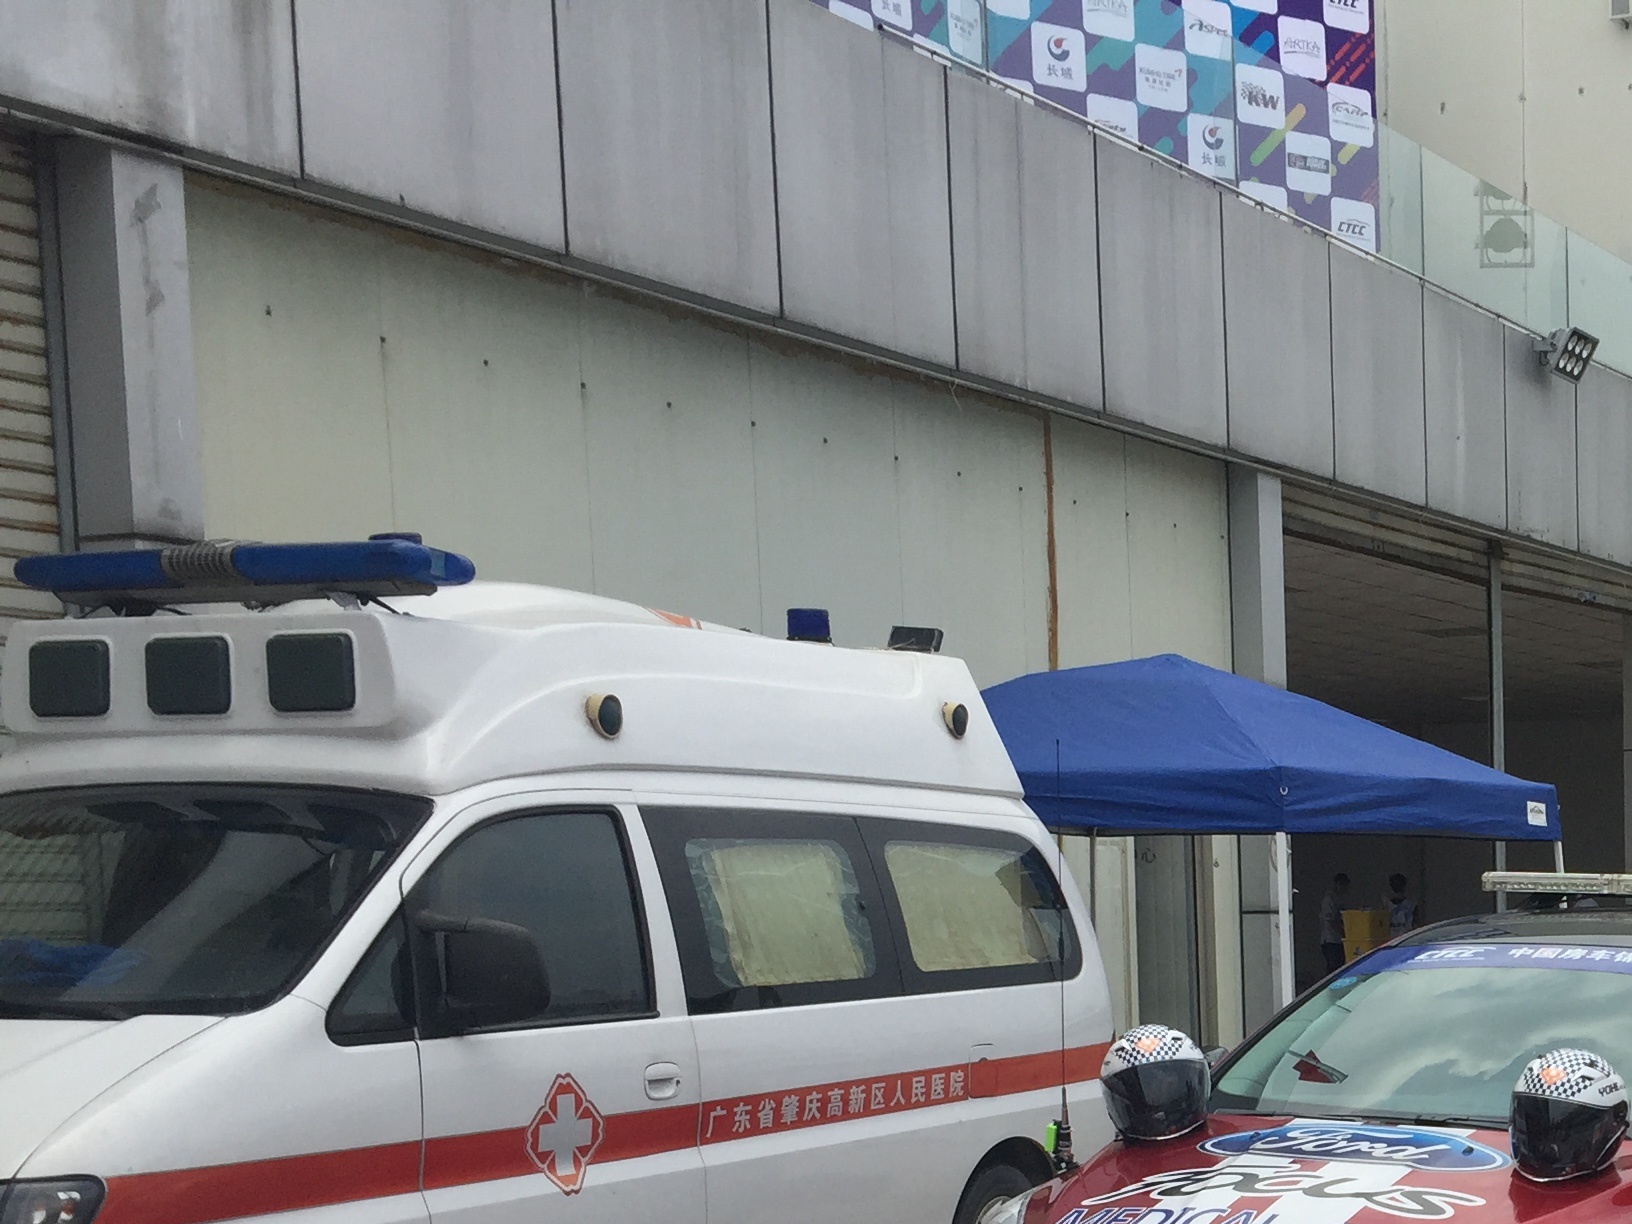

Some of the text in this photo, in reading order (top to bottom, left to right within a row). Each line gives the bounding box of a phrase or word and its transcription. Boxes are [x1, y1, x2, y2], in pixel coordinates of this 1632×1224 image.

[1338, 222, 1367, 236] CTCC
[705, 1069, 966, 1139] 广东省肇庆高新区人民医院
[1259, 1125, 1440, 1162] Ford
